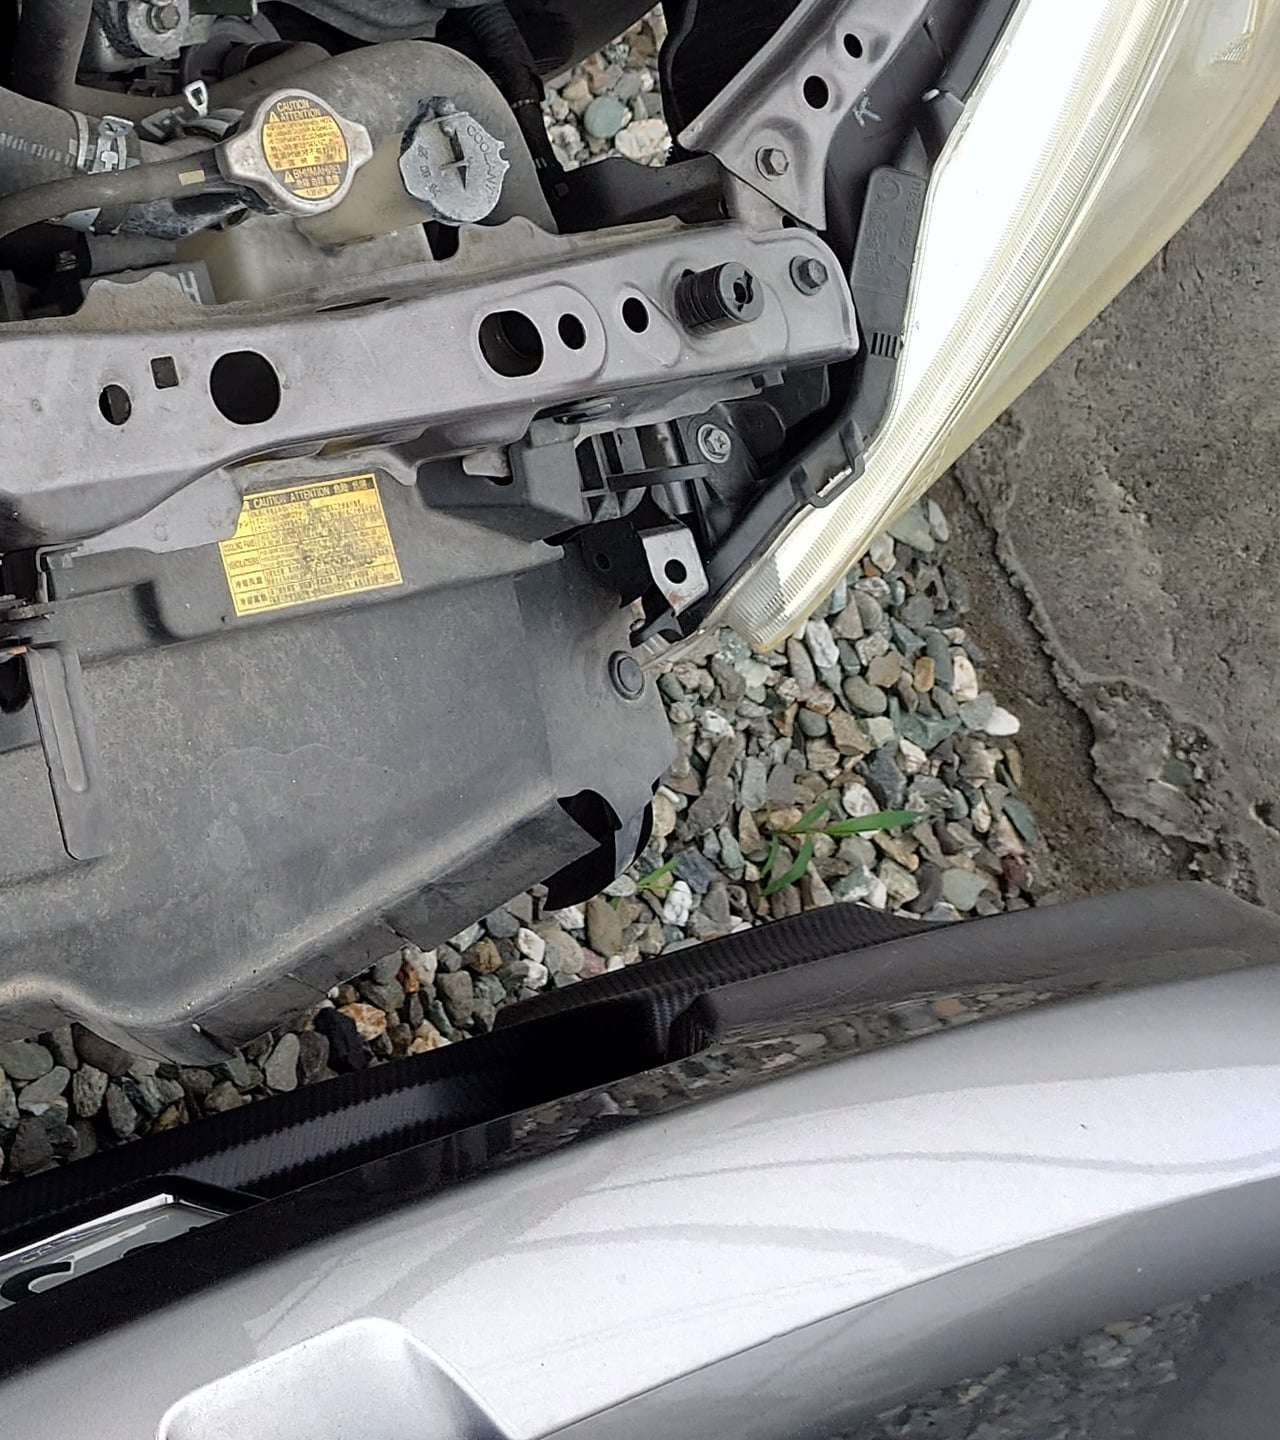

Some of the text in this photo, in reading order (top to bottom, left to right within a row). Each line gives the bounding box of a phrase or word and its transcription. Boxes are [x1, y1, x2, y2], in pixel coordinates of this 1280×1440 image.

[276, 100, 310, 112] CAUTION
[280, 108, 322, 121] ATTENTION
[467, 124, 497, 196] COOLANT
[253, 494, 287, 508] CAUTION
[290, 486, 330, 502] ATTENTION
